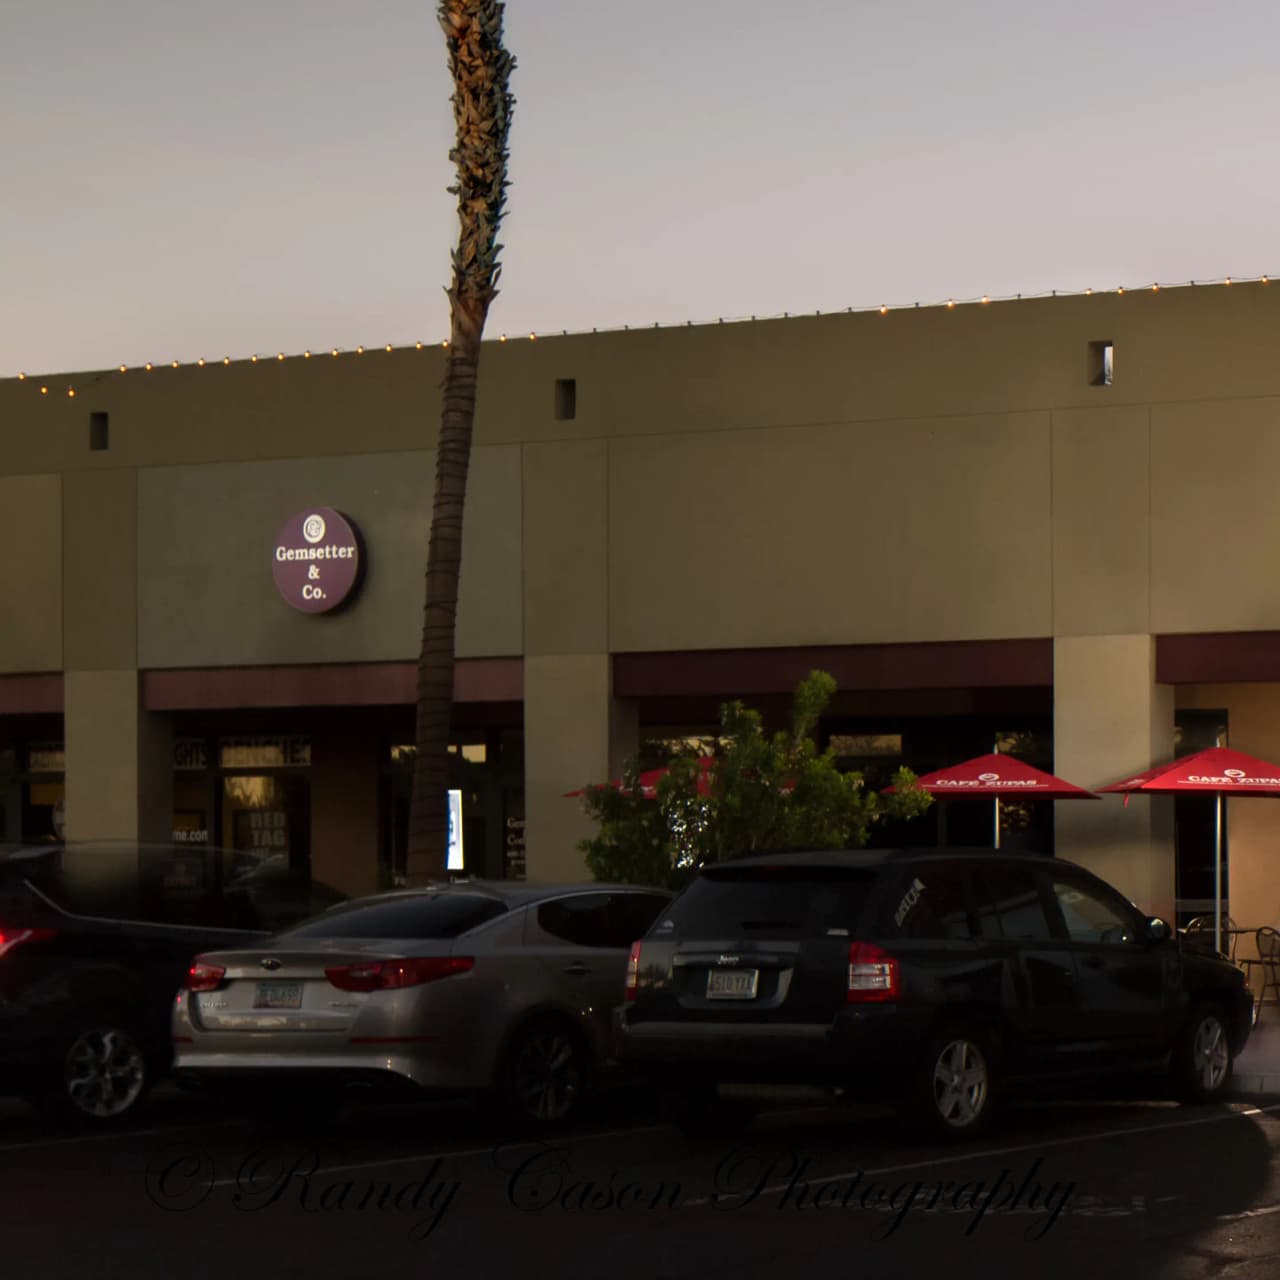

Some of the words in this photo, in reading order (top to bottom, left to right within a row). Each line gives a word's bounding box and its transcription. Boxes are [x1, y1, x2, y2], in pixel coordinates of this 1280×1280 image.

[275, 545, 355, 562] Gemsetter
[307, 564, 321, 580] &
[302, 584, 327, 600] Co.
[250, 811, 286, 829] RED
[251, 829, 286, 847] TAG
